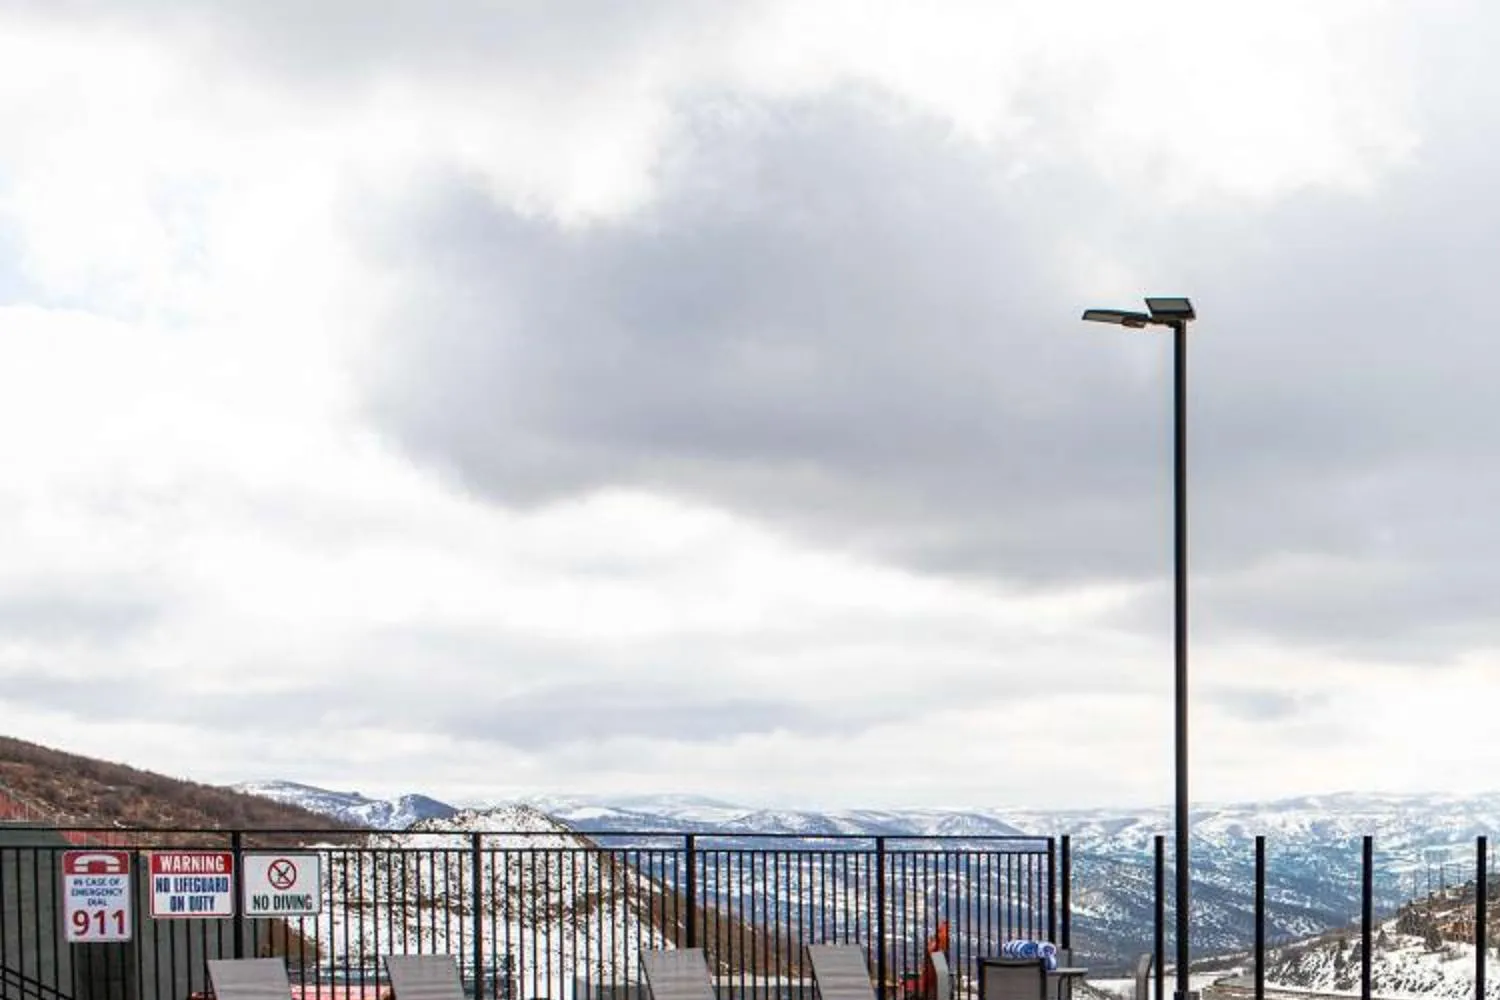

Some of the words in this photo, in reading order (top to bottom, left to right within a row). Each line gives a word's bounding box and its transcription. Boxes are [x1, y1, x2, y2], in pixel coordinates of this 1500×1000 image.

[160, 856, 225, 872] WARNING
[86, 878, 106, 886] CASE
[156, 877, 171, 892] NO
[174, 877, 229, 893] LIFEGUARD
[71, 888, 123, 897] EMERGENCY
[87, 898, 107, 907] DIAL
[170, 896, 184, 912] ON
[189, 895, 215, 912] DUTY
[253, 894, 269, 910] NO
[273, 894, 313, 910] DIVING
[72, 910, 125, 936] 911
